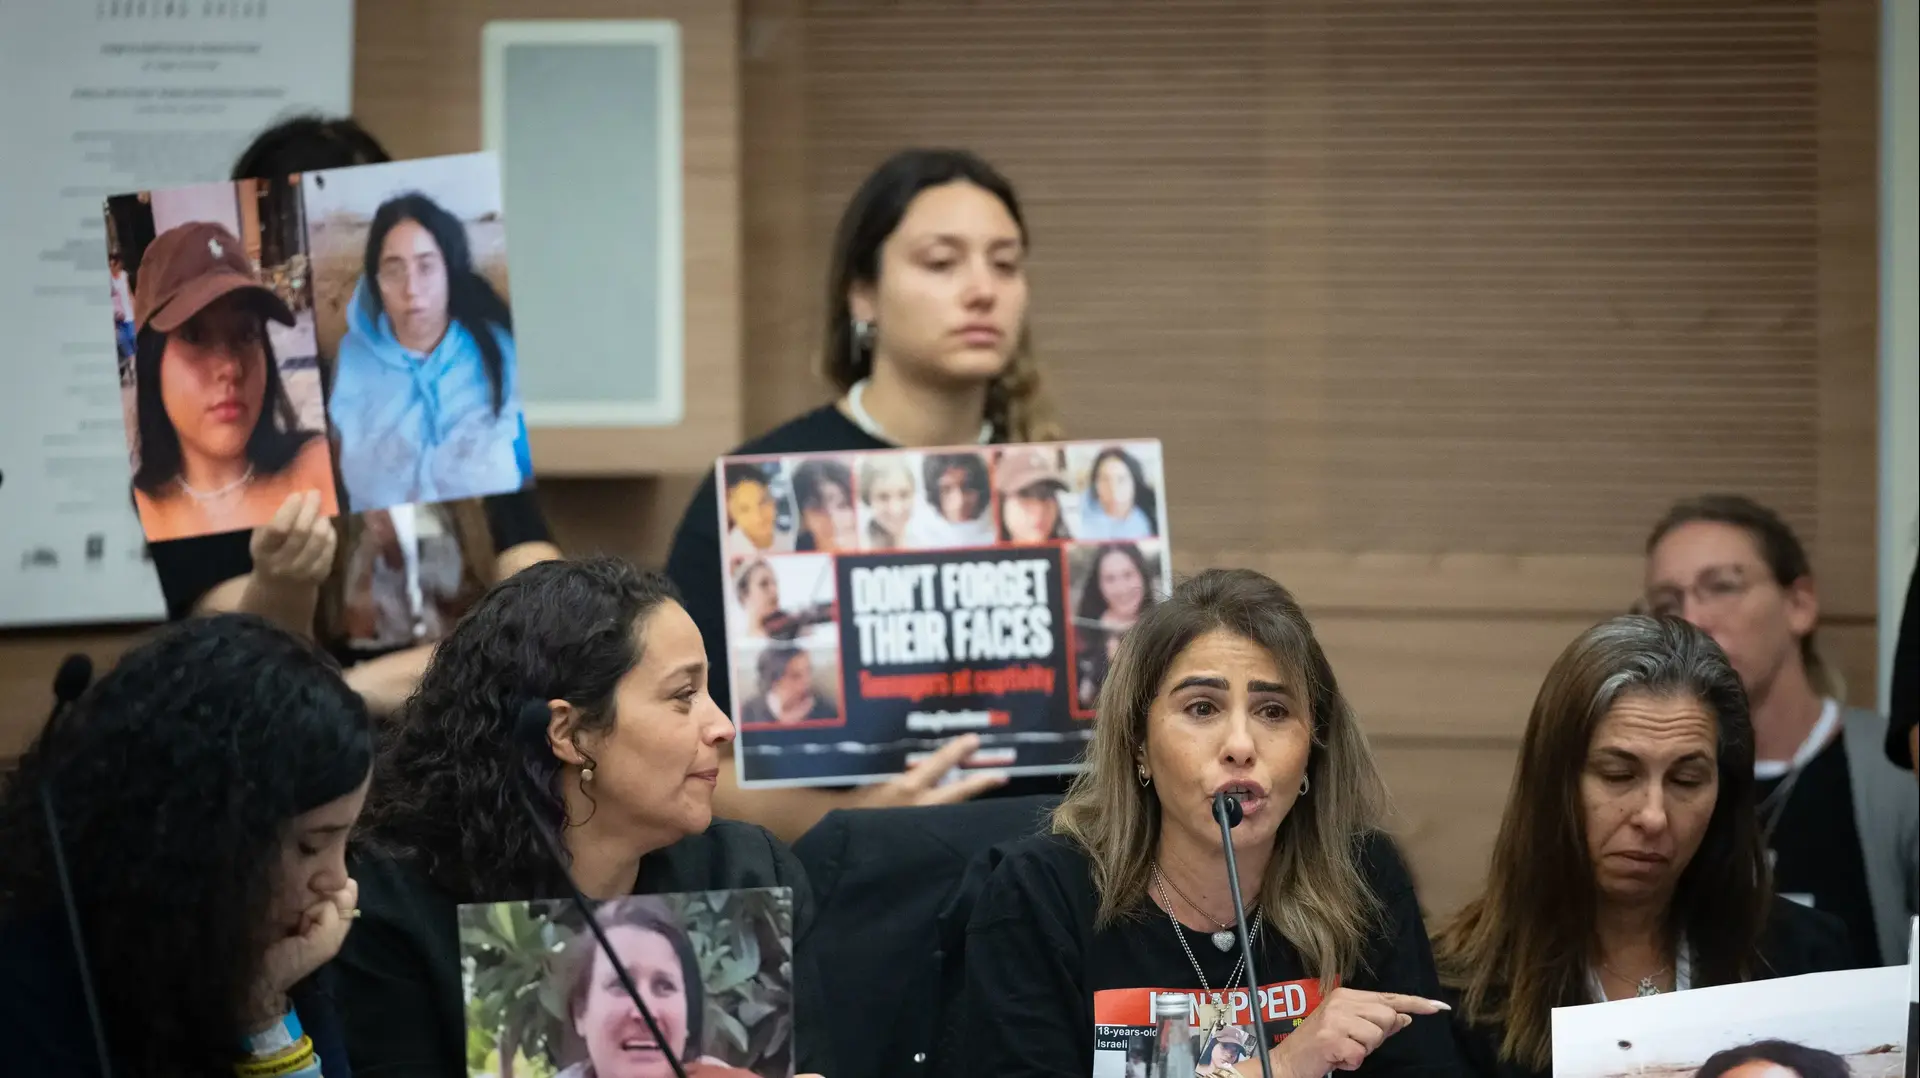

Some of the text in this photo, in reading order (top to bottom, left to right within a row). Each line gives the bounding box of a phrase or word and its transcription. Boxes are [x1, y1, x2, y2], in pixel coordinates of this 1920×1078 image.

[851, 558, 1051, 614] DON'T FORGET
[853, 605, 1054, 666] THEIR FACES
[1097, 1039, 1128, 1049] Israeli
